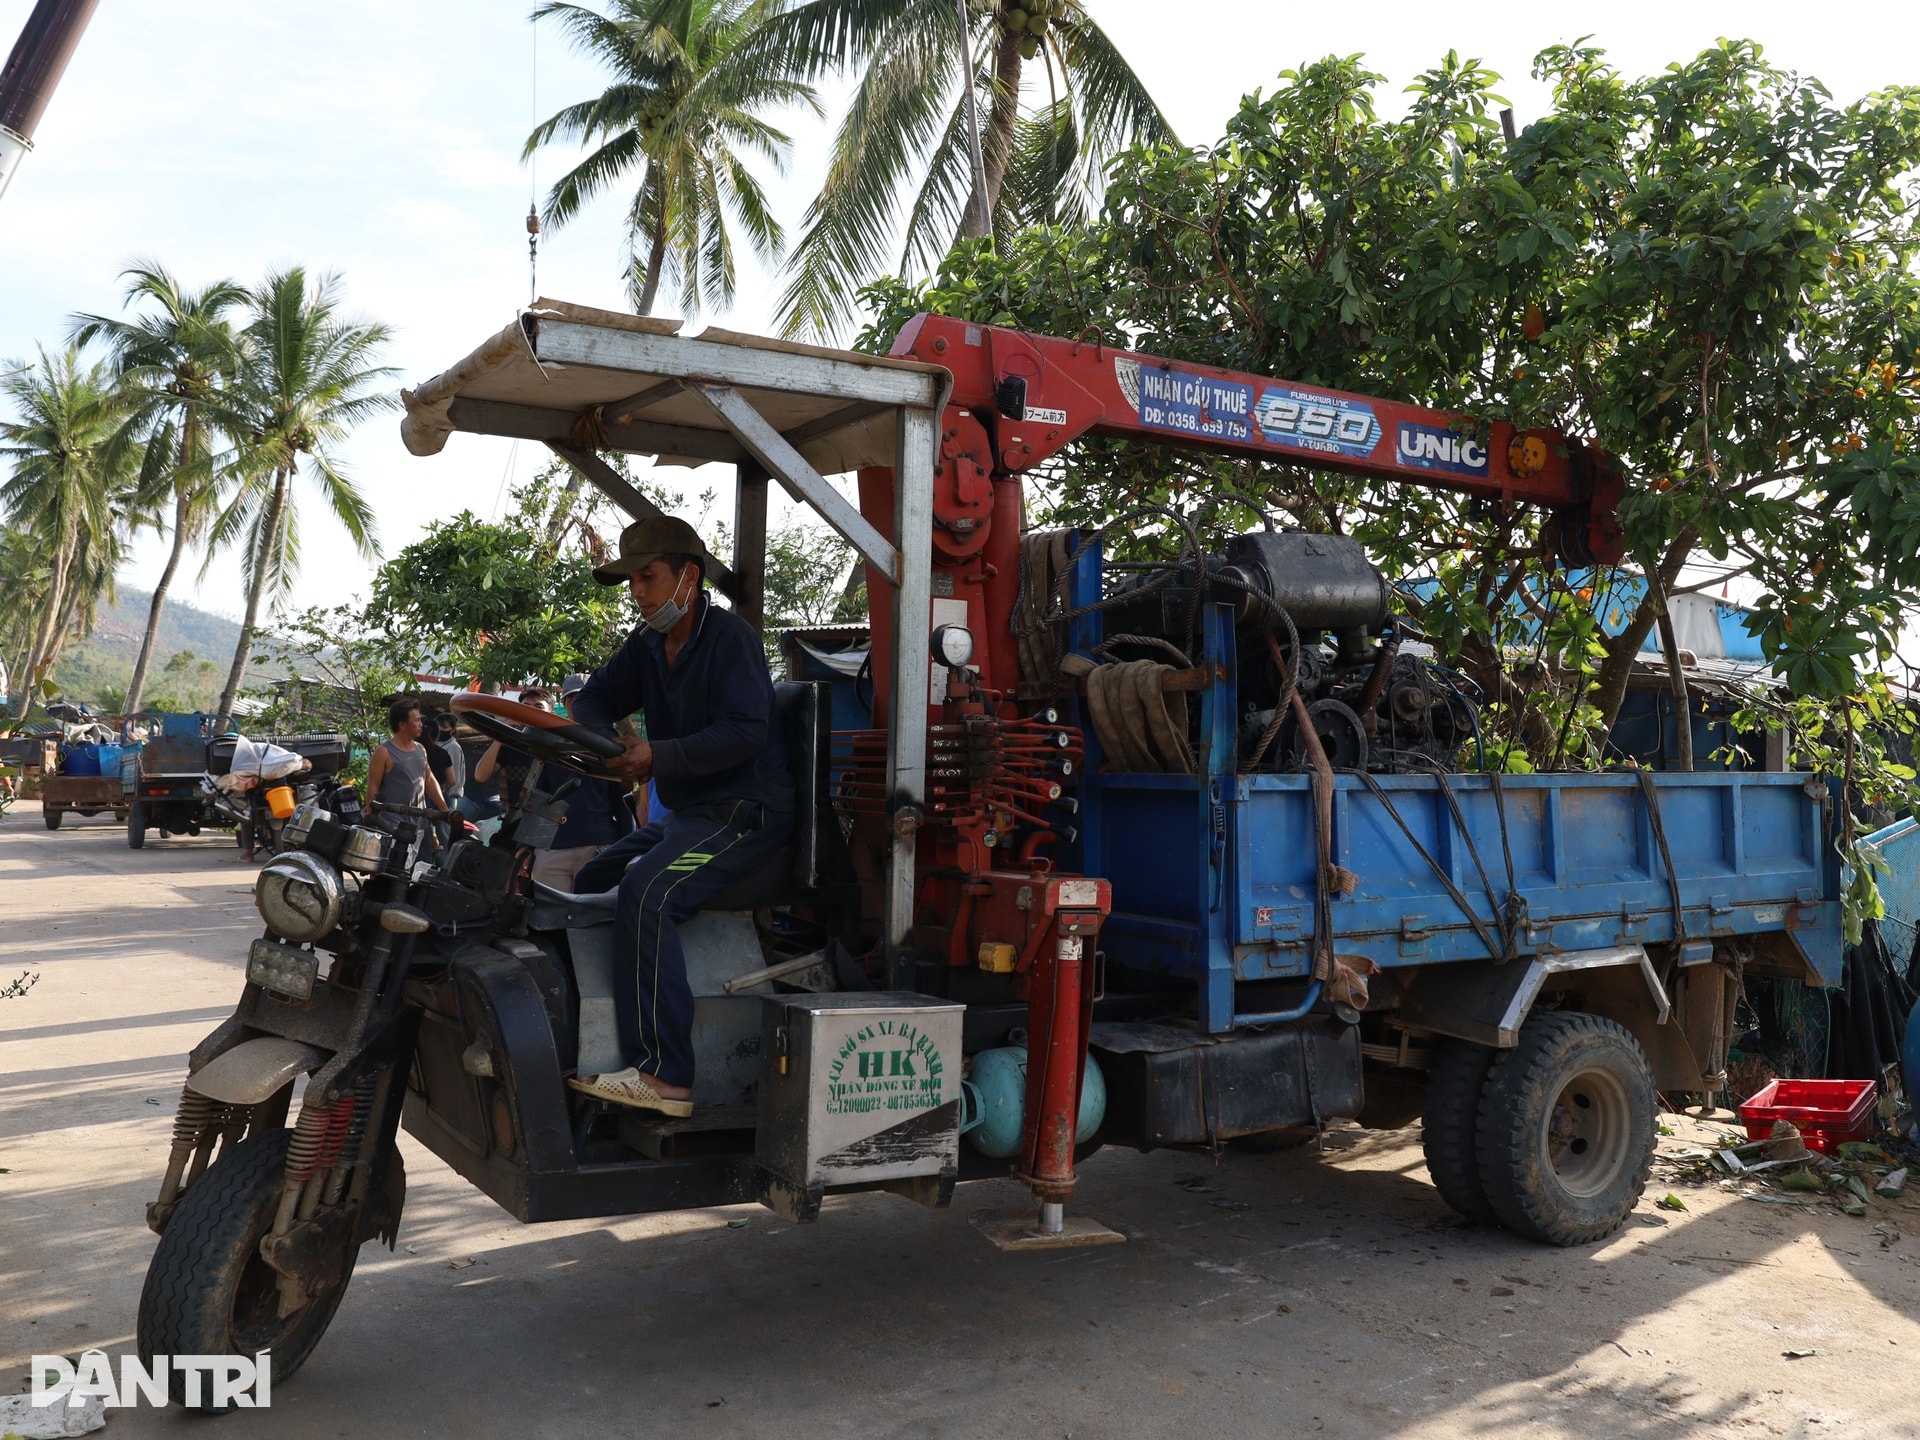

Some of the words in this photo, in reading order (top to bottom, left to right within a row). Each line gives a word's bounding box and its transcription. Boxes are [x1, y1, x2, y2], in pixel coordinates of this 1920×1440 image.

[1144, 374, 1181, 406] NHẬN
[1214, 389, 1247, 414] THUÊ
[1290, 391, 1332, 405] FURUKAWA
[1144, 407, 1165, 424] DĐ:
[1263, 399, 1372, 441] 250
[1401, 430, 1486, 467] UNIC
[878, 1020, 896, 1036] XE
[858, 1050, 917, 1078] HK
[901, 1080, 917, 1091] XE
